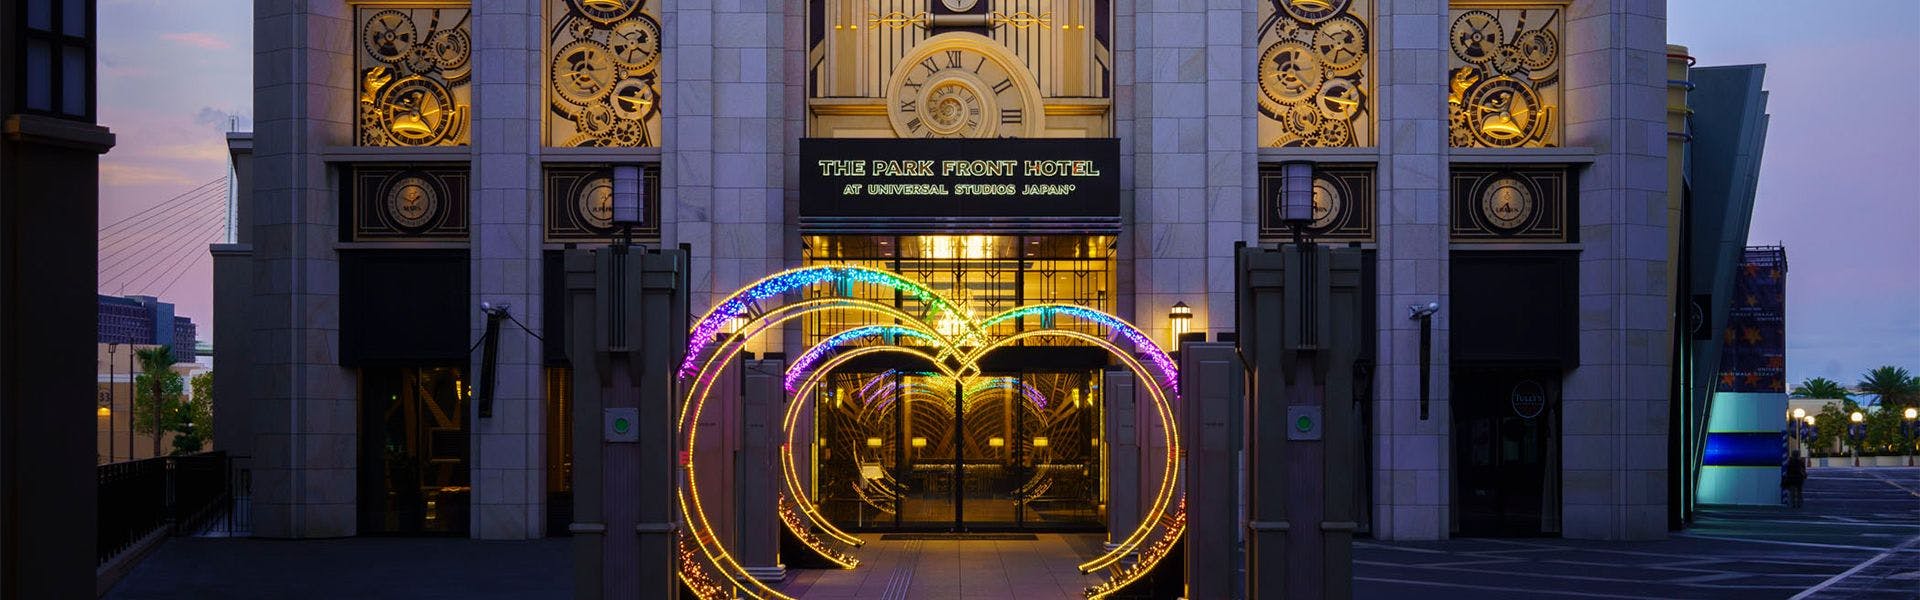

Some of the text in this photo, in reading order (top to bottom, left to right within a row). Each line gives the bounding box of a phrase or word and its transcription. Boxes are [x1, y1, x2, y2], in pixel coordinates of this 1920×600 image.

[818, 160, 1100, 176] THE PARK FRONT HOTEL
[843, 184, 863, 195] AT
[867, 184, 949, 195] UNIVERSAL
[954, 184, 1016, 195] STUDIOS
